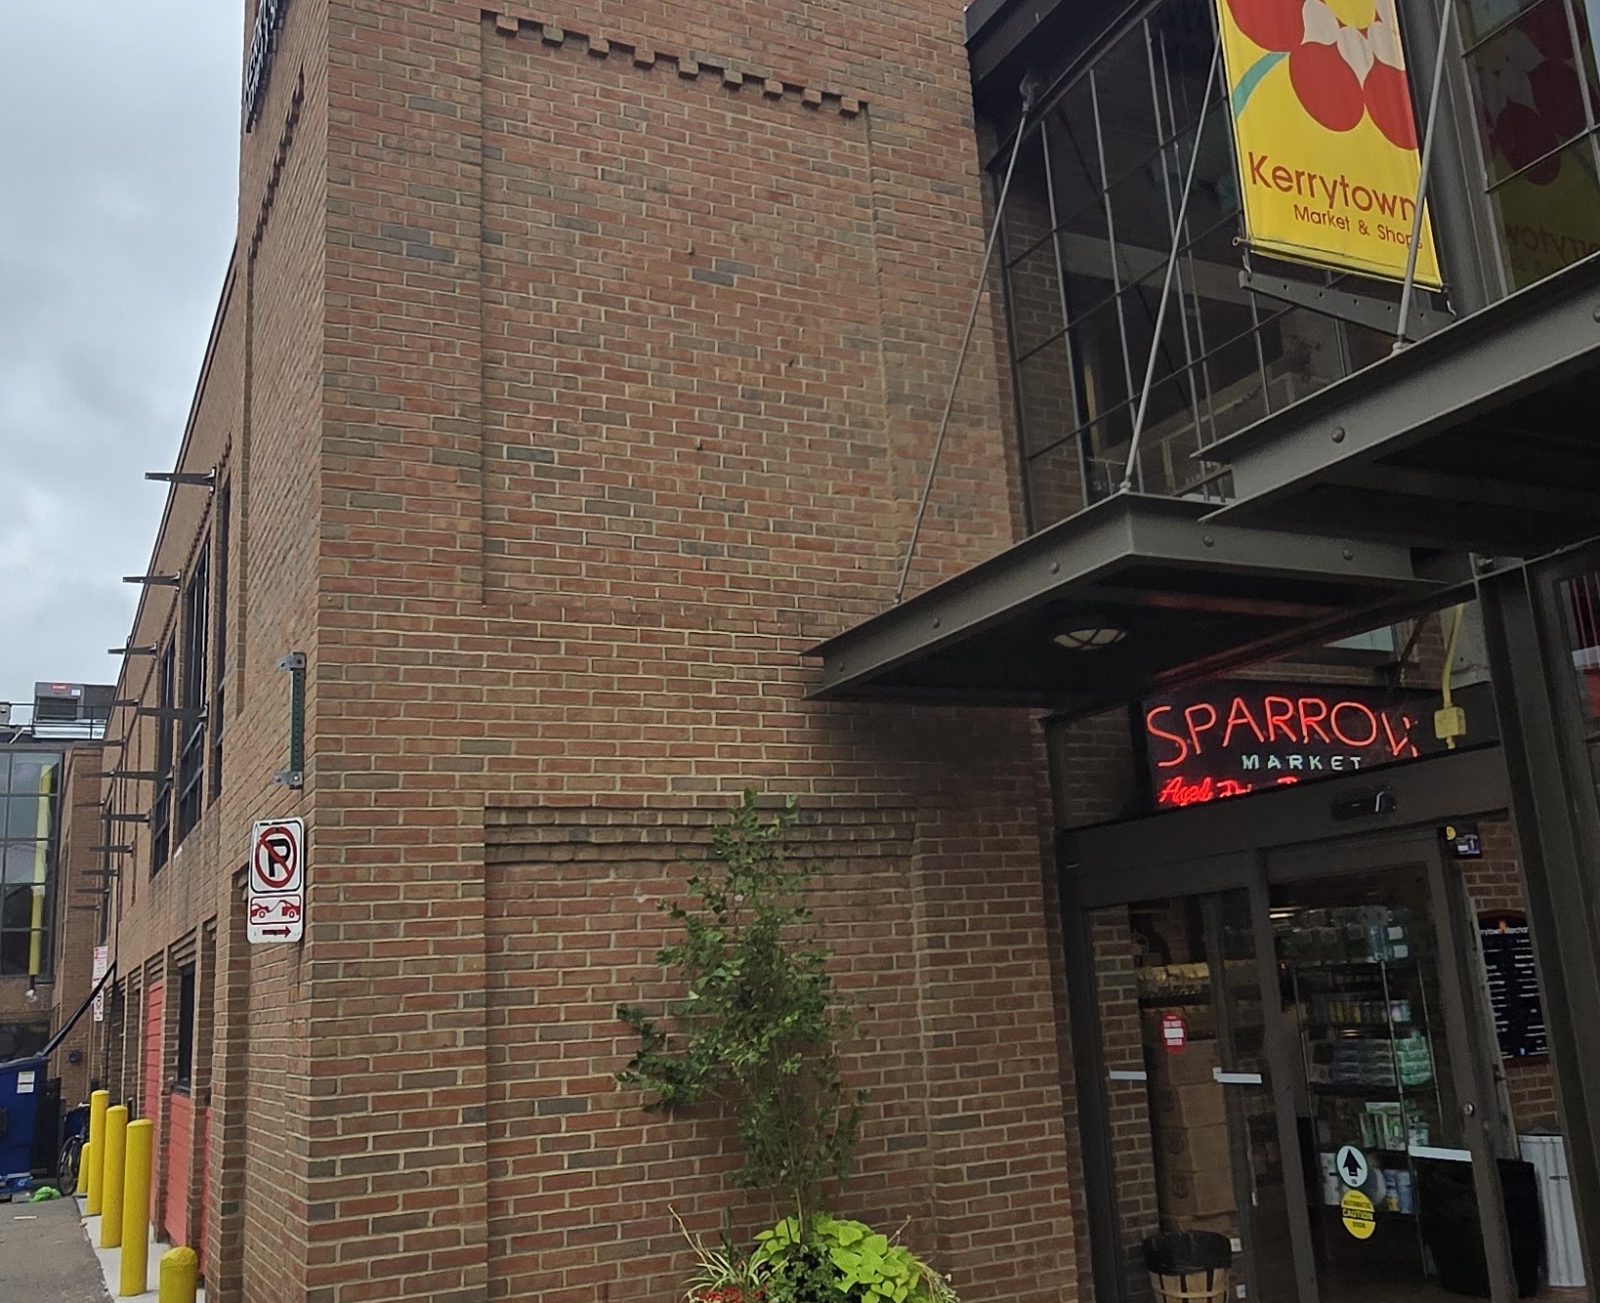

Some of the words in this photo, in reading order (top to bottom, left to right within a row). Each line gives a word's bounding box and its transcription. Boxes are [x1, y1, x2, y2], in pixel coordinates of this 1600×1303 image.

[1248, 151, 1417, 222] Kerrytown
[1293, 204, 1350, 232] Market
[1358, 220, 1370, 237] &
[1241, 754, 1362, 771] MARKET
